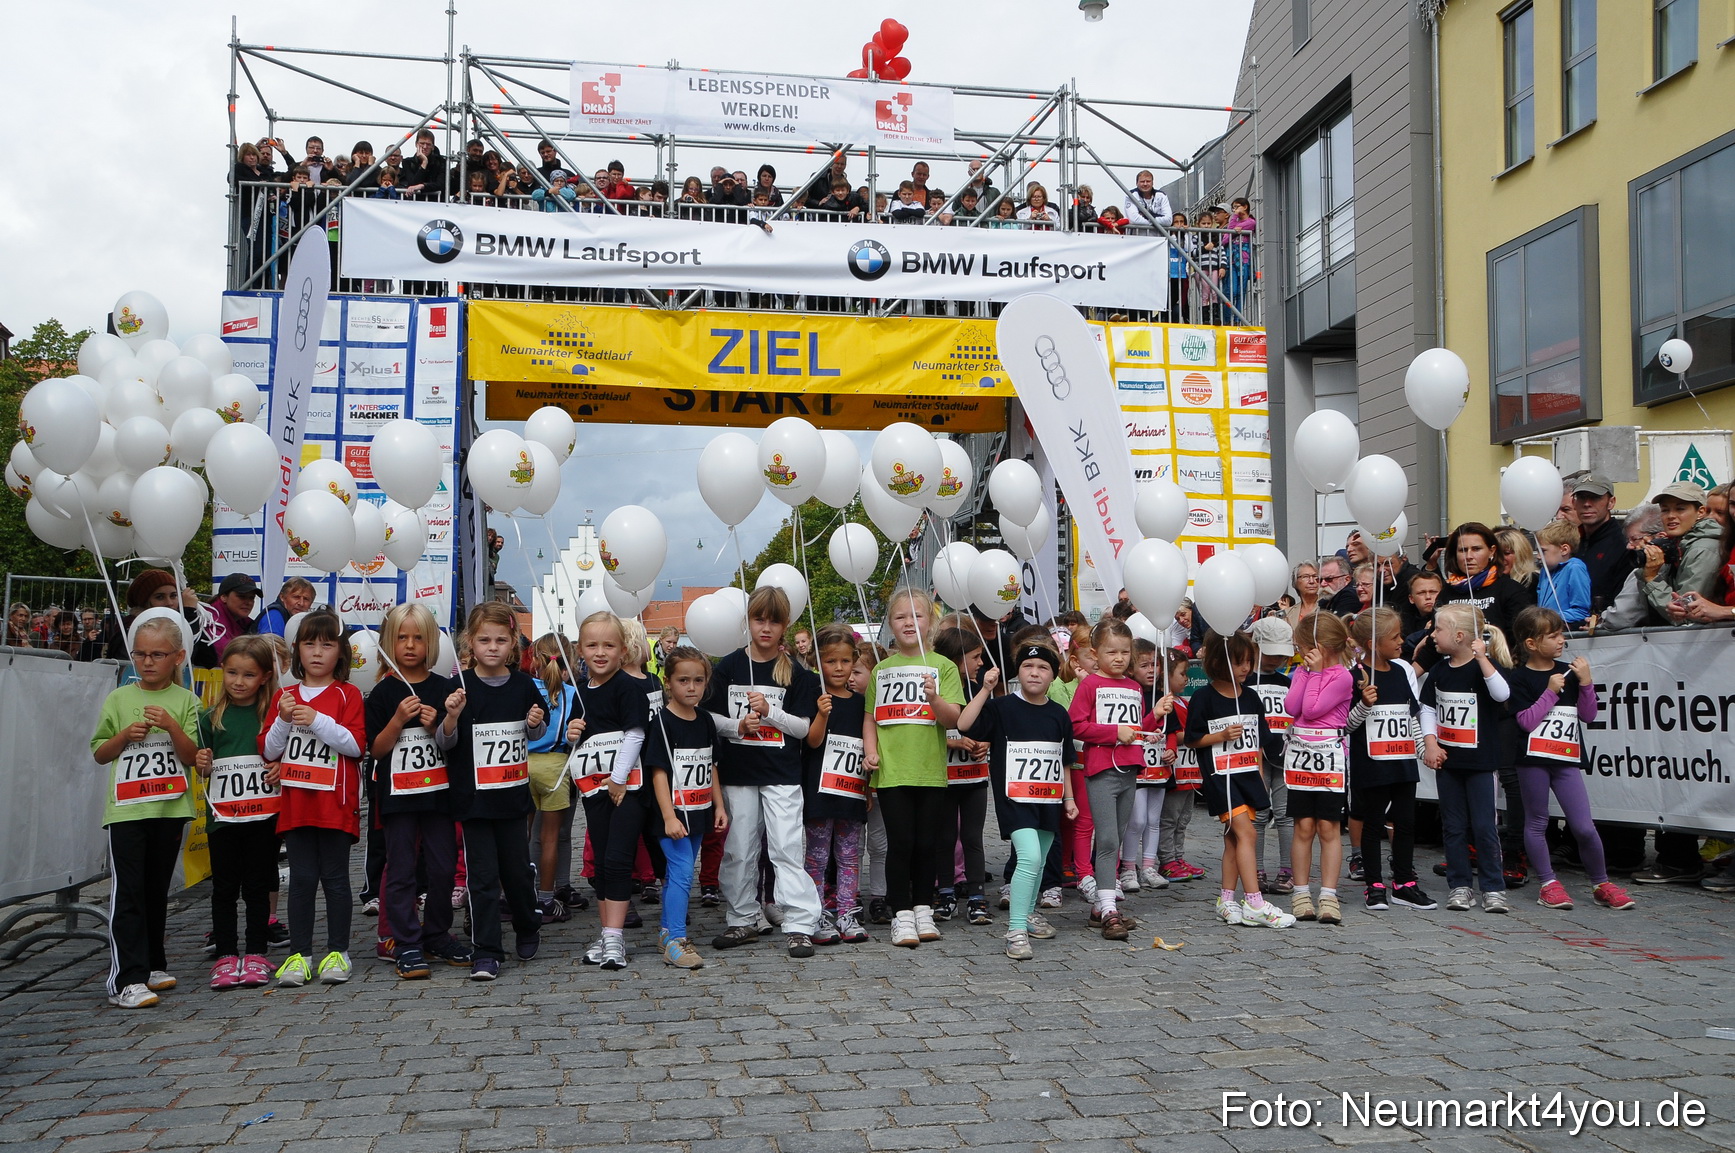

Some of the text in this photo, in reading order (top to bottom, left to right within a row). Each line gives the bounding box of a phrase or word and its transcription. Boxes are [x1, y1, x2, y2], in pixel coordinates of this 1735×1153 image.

[688, 76, 830, 100] LEBENSSPENDER
[582, 103, 614, 115] DKMS
[721, 101, 799, 120] WERDEN!
[724, 121, 796, 134] www.dkms.de
[876, 120, 907, 133] DKMS
[475, 233, 701, 268] BMW Laufsport
[901, 251, 1106, 283] BMW Laufsport
[500, 344, 633, 361] Neumarkter Stadtlauf
[707, 328, 841, 376] ZIEL
[1127, 349, 1150, 357] KANN
[350, 361, 402, 377] Xplus1
[912, 360, 980, 372] Neumarkter
[515, 388, 631, 402] Neumarkter Stadtlauf
[283, 376, 301, 445] BKK
[872, 399, 979, 412] Neumarkter Stadtlauf
[349, 411, 399, 419] HACKNER
[350, 448, 366, 456] GUT
[1069, 419, 1101, 482] BKK
[1179, 469, 1221, 481] NATHUS
[275, 455, 293, 533] Audi
[1093, 487, 1125, 560] Audi
[878, 673, 896, 681] PARTL
[475, 729, 500, 738] PARTL
[828, 740, 850, 749] PARTL
[1385, 744, 1402, 753] Jule
[482, 738, 527, 765] 7255
[122, 751, 178, 780] 7235
[577, 749, 617, 776] 717
[1291, 749, 1336, 771] 7281
[1580, 745, 1731, 784] Verbrauch.
[211, 763, 232, 773] PARTL
[285, 767, 311, 780] Anna
[502, 768, 520, 780] Jule
[1015, 758, 1061, 782] 7279
[1295, 773, 1331, 785] Hermine
[139, 782, 167, 795] Alina
[230, 802, 263, 815] Vivien
